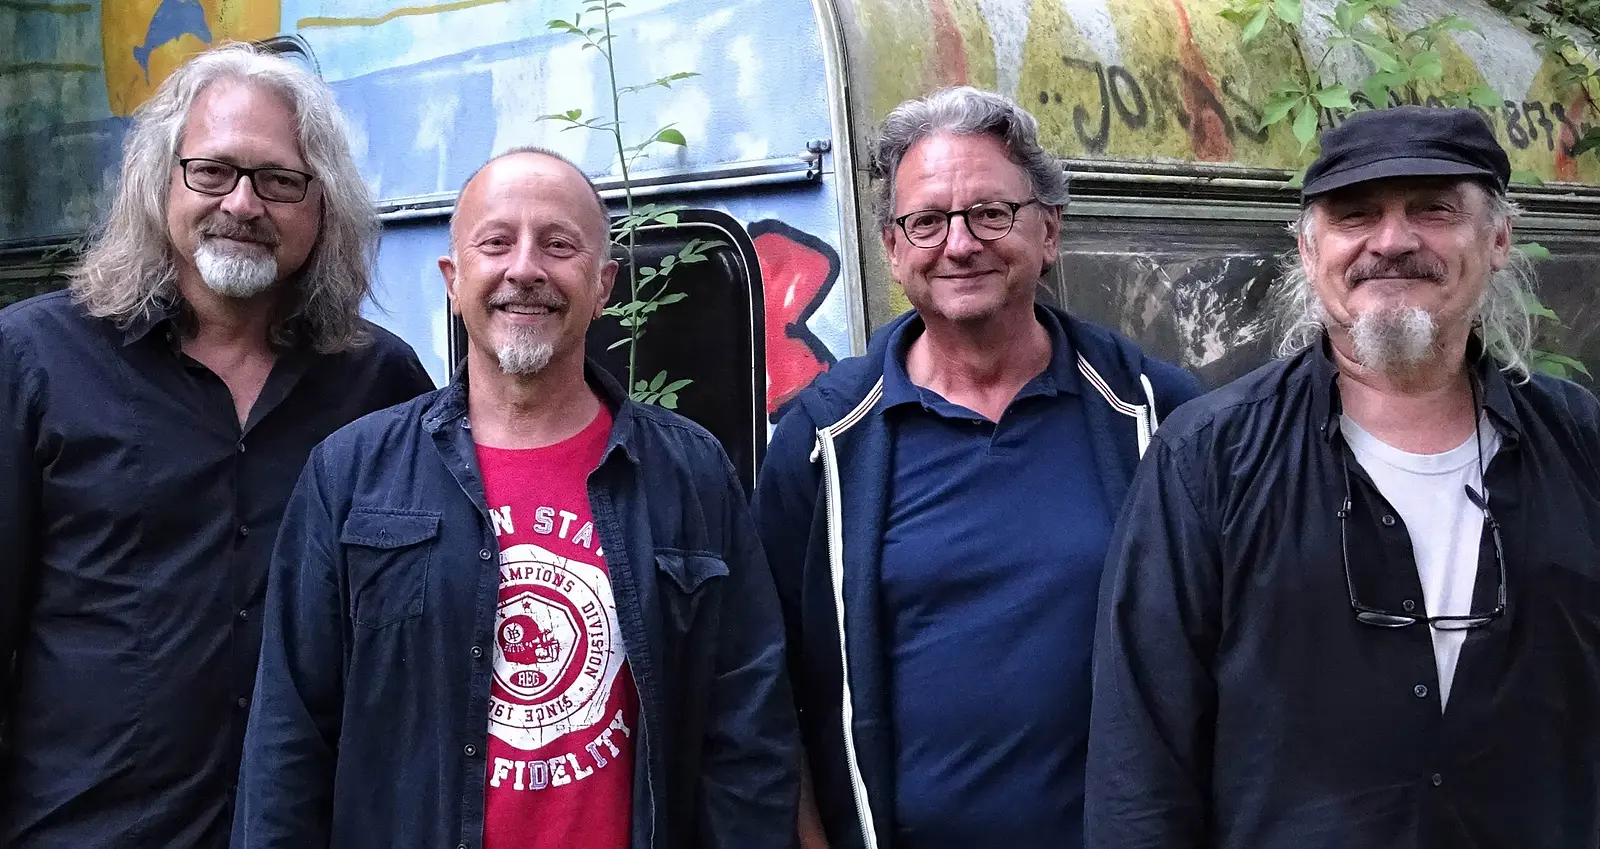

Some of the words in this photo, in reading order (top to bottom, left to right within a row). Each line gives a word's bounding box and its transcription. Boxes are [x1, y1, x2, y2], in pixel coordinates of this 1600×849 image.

[533, 506, 604, 557] STA
[581, 600, 604, 680] DIVISION
[524, 695, 573, 722] SINCE
[489, 709, 631, 791] FIDELITY
